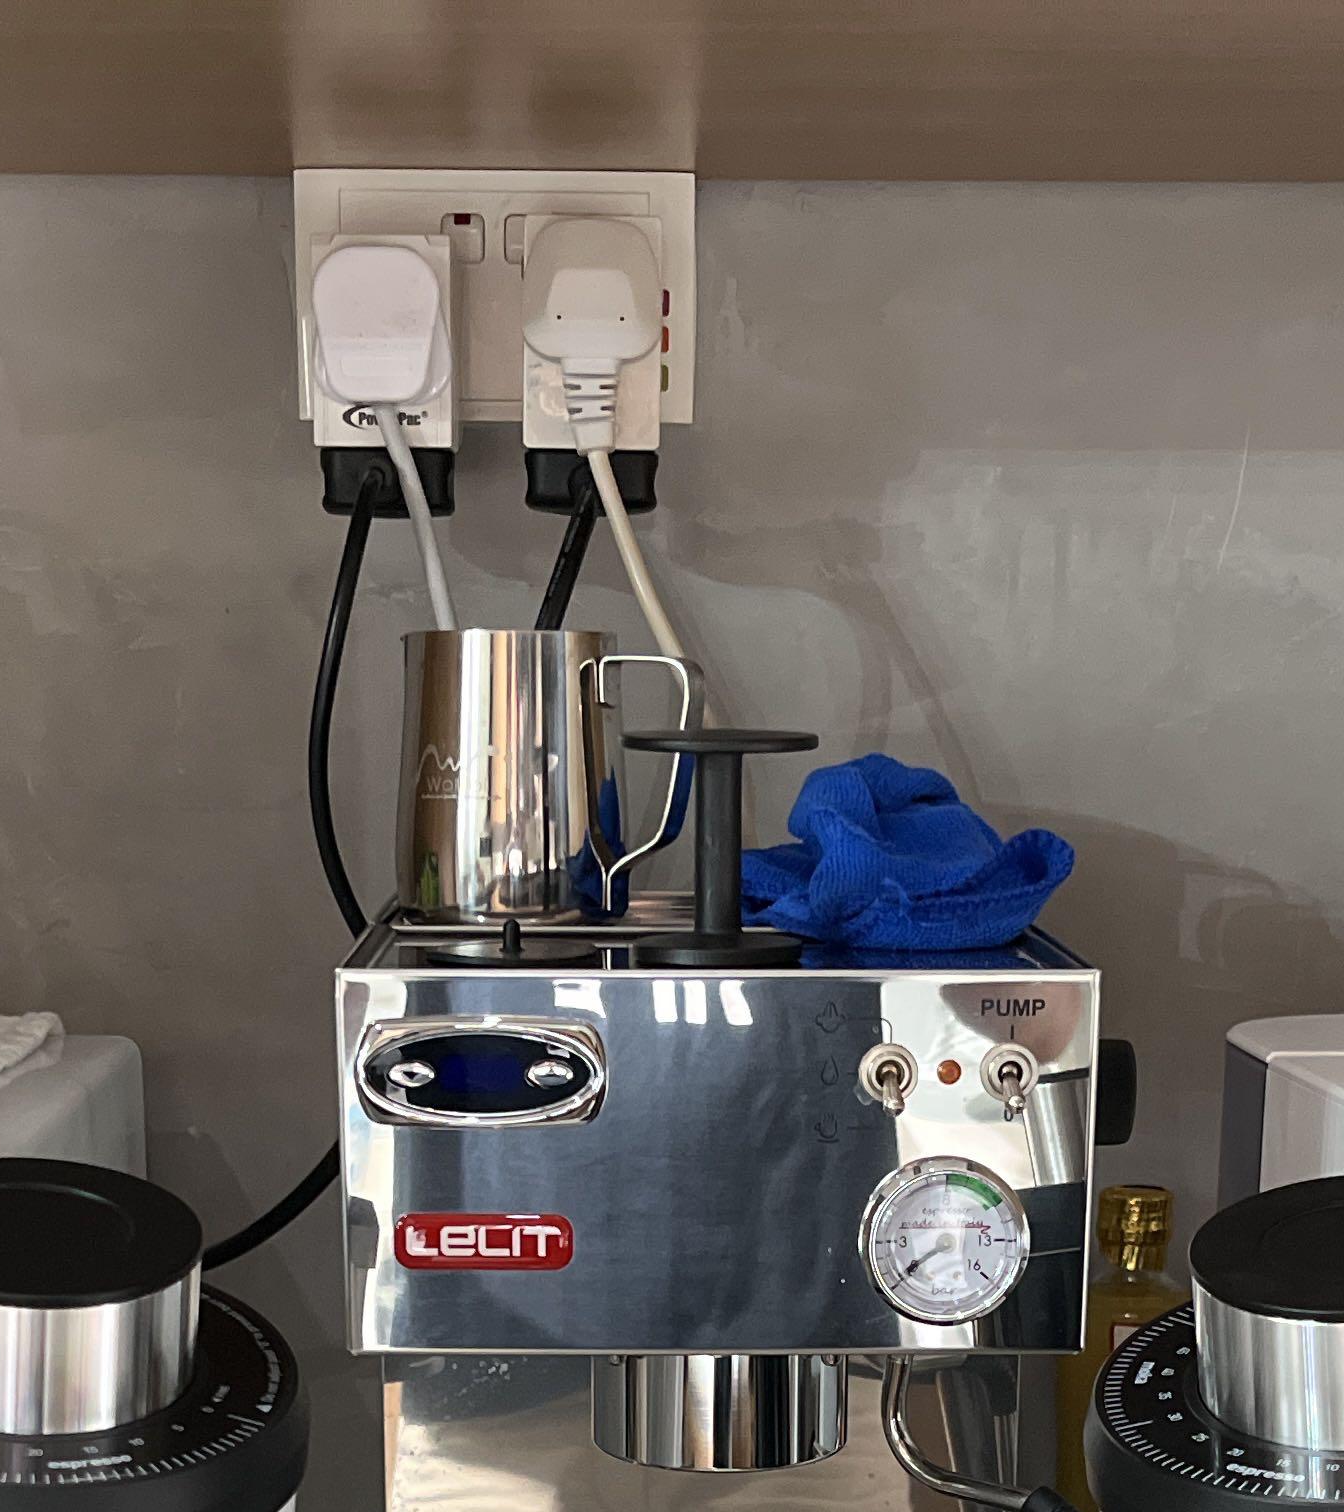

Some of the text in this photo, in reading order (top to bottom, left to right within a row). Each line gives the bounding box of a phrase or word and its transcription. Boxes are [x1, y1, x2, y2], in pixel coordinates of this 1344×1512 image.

[980, 998, 1046, 1016] PUMP
[898, 1235, 908, 1248] 3
[978, 1234, 993, 1247] 13
[967, 1258, 981, 1271] 16
[931, 1284, 957, 1296] bar
[48, 1454, 133, 1470] espresso
[1326, 1463, 1341, 1472] 10
[1226, 1463, 1306, 1483] espresso
